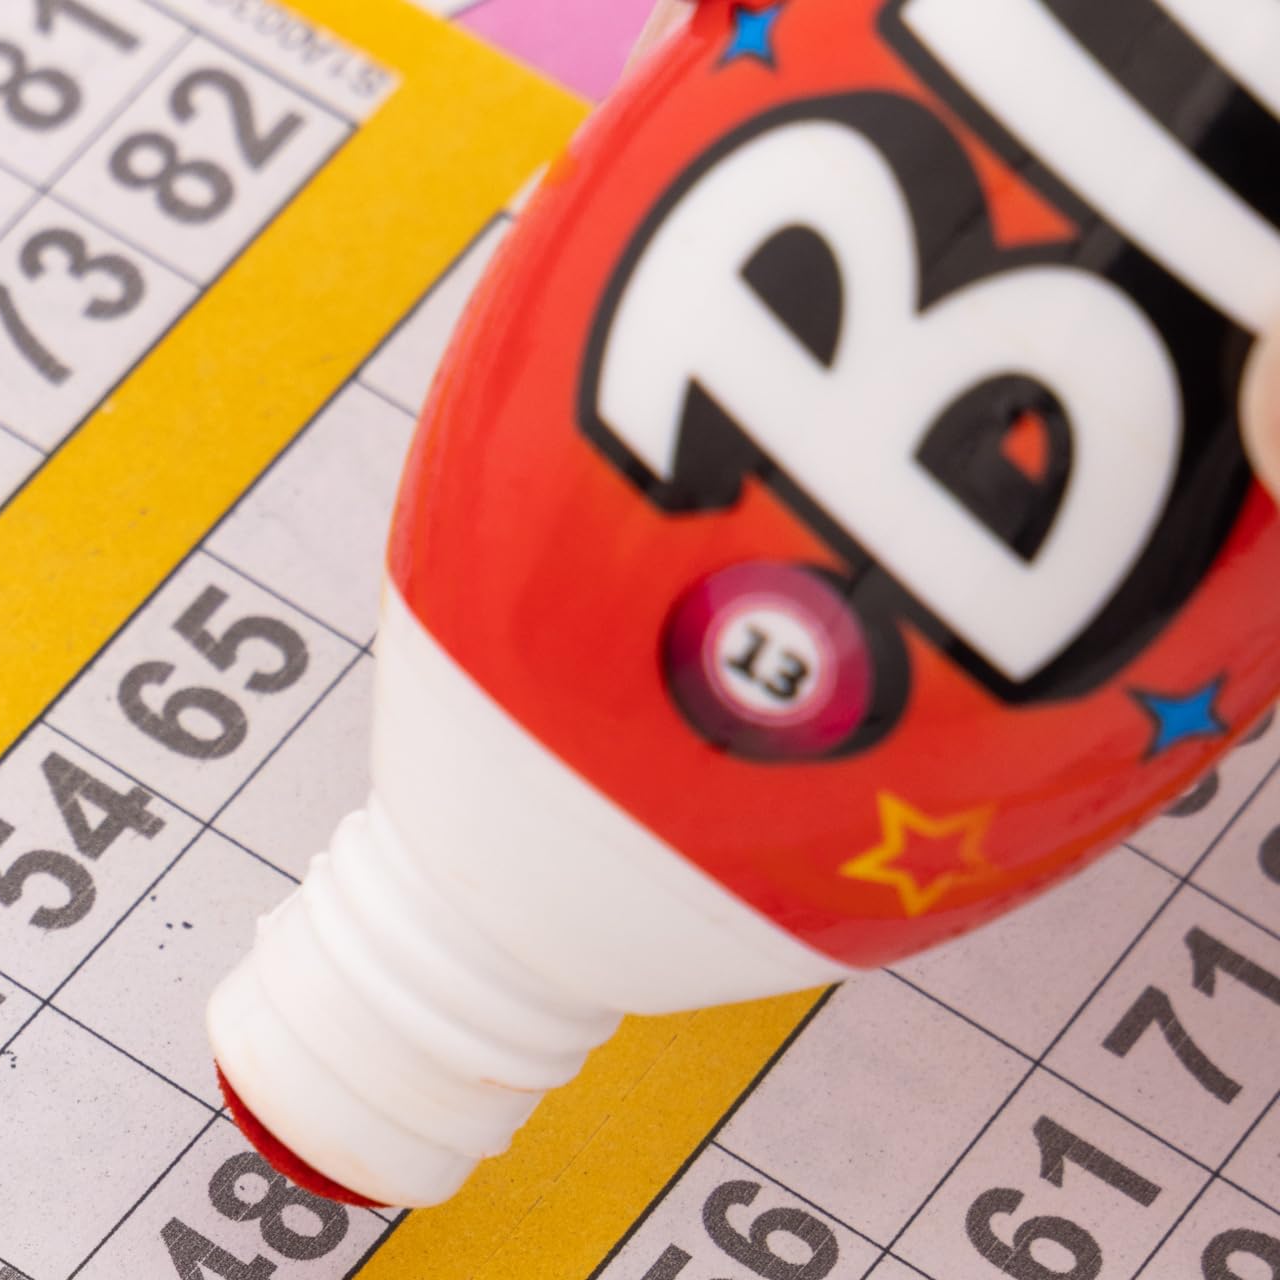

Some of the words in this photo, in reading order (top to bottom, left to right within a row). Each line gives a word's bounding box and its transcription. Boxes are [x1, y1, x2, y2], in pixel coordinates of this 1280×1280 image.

[109, 66, 306, 226] 82
[118, 585, 310, 760] 65
[728, 624, 810, 702] 13
[1102, 925, 1280, 1105] 71
